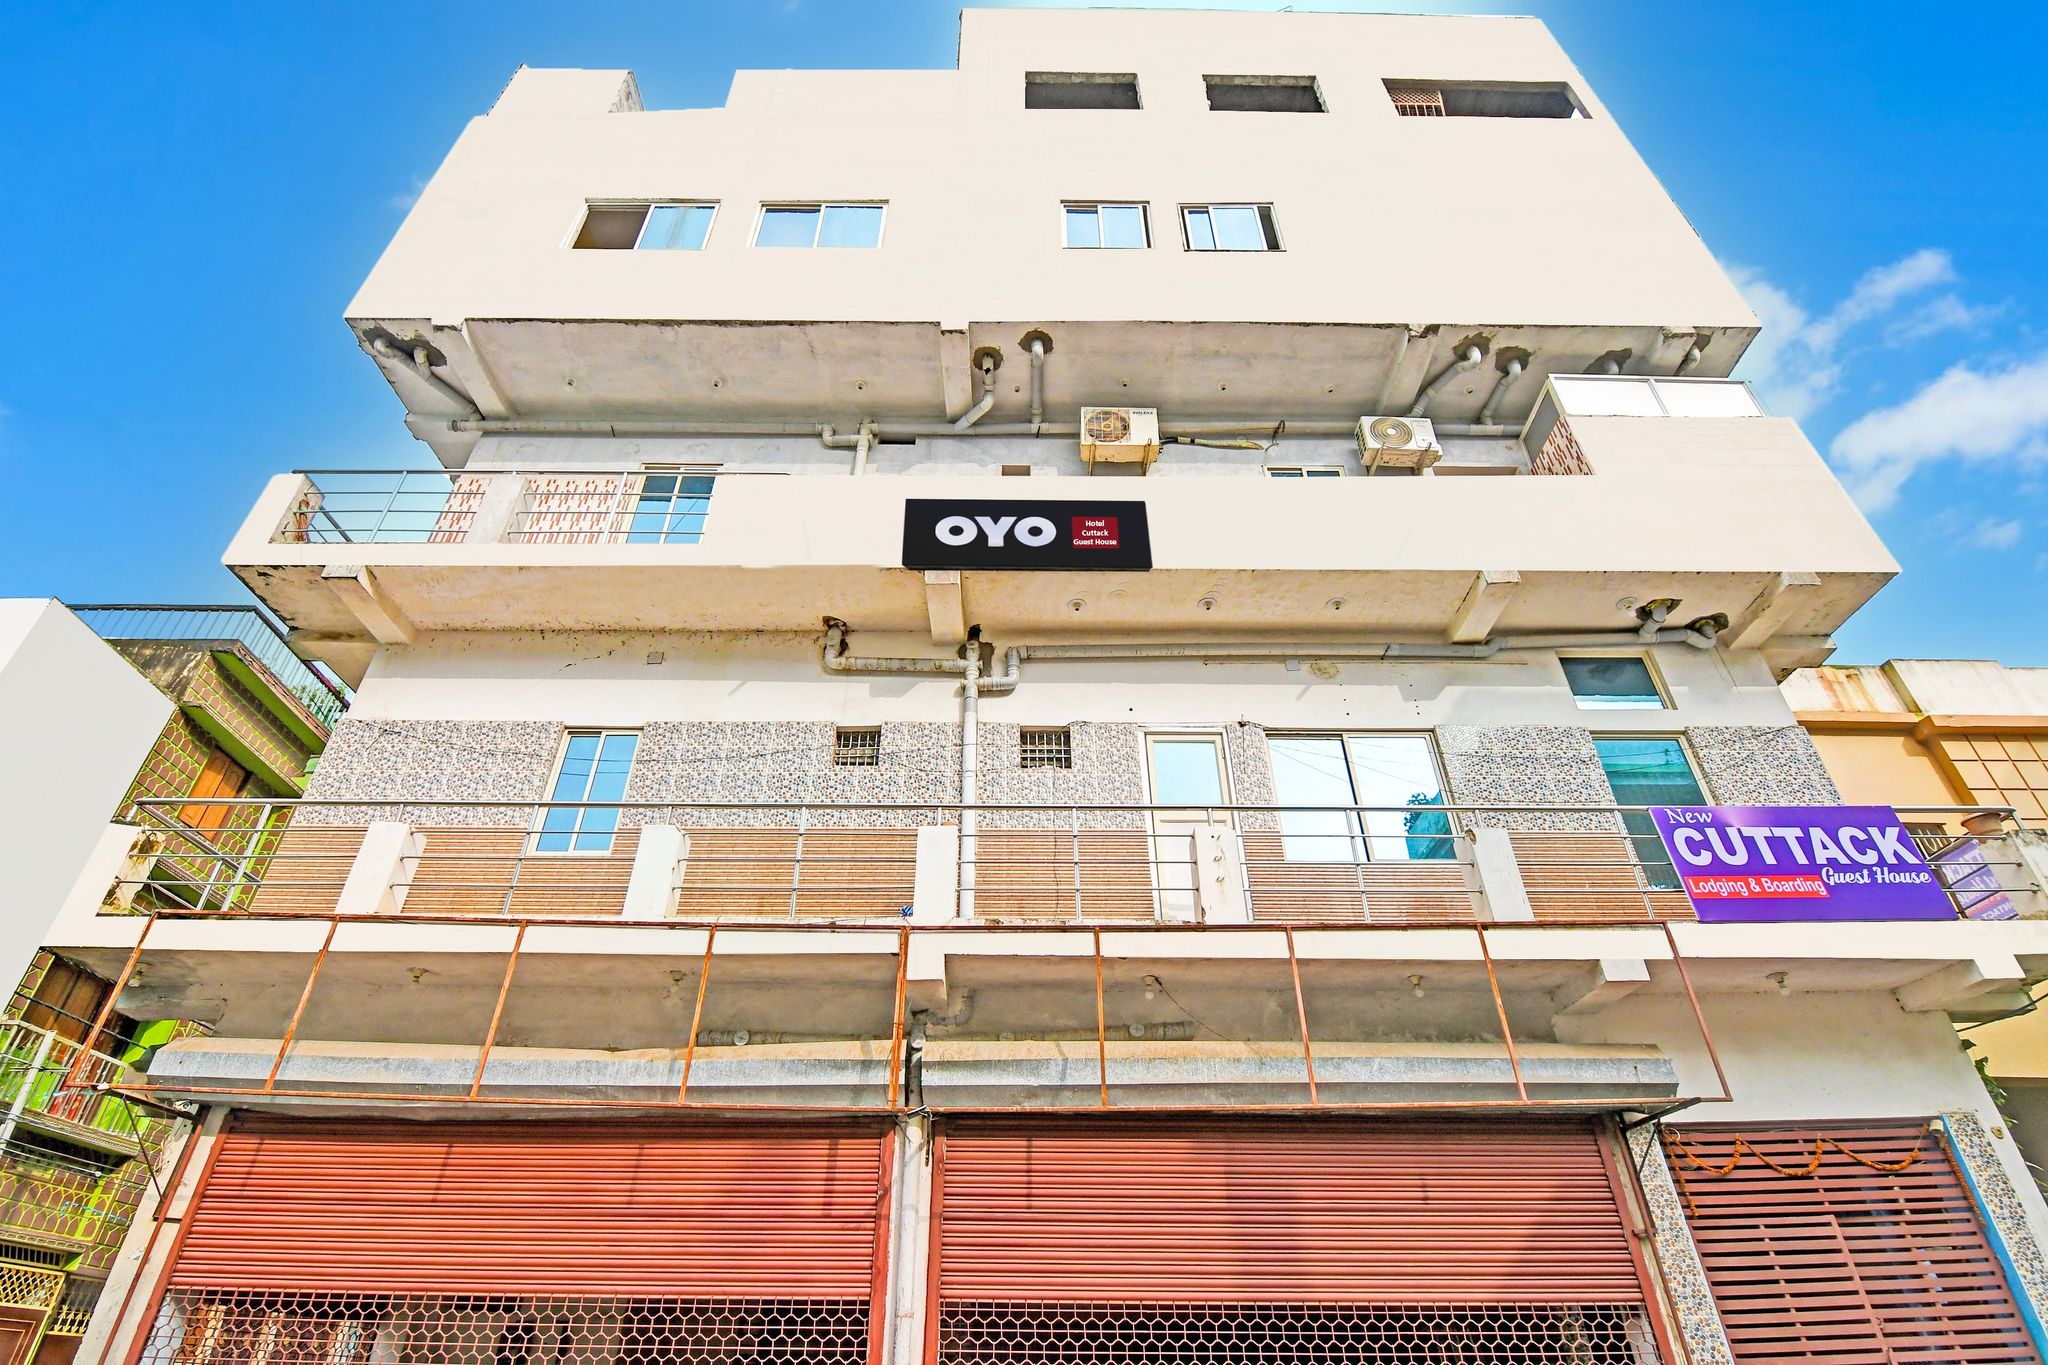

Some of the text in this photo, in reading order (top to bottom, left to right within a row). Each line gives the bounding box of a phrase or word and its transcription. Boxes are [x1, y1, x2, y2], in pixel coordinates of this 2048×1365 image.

[934, 515, 1057, 548] OYO
[1081, 529, 1109, 537] Cuttack
[1073, 538, 1094, 546] Guest
[1664, 808, 1713, 825] New
[1673, 826, 1923, 866] CUTTACK
[1821, 866, 1932, 886] Guest House
[1688, 877, 1827, 897] Lodging & Boarding
